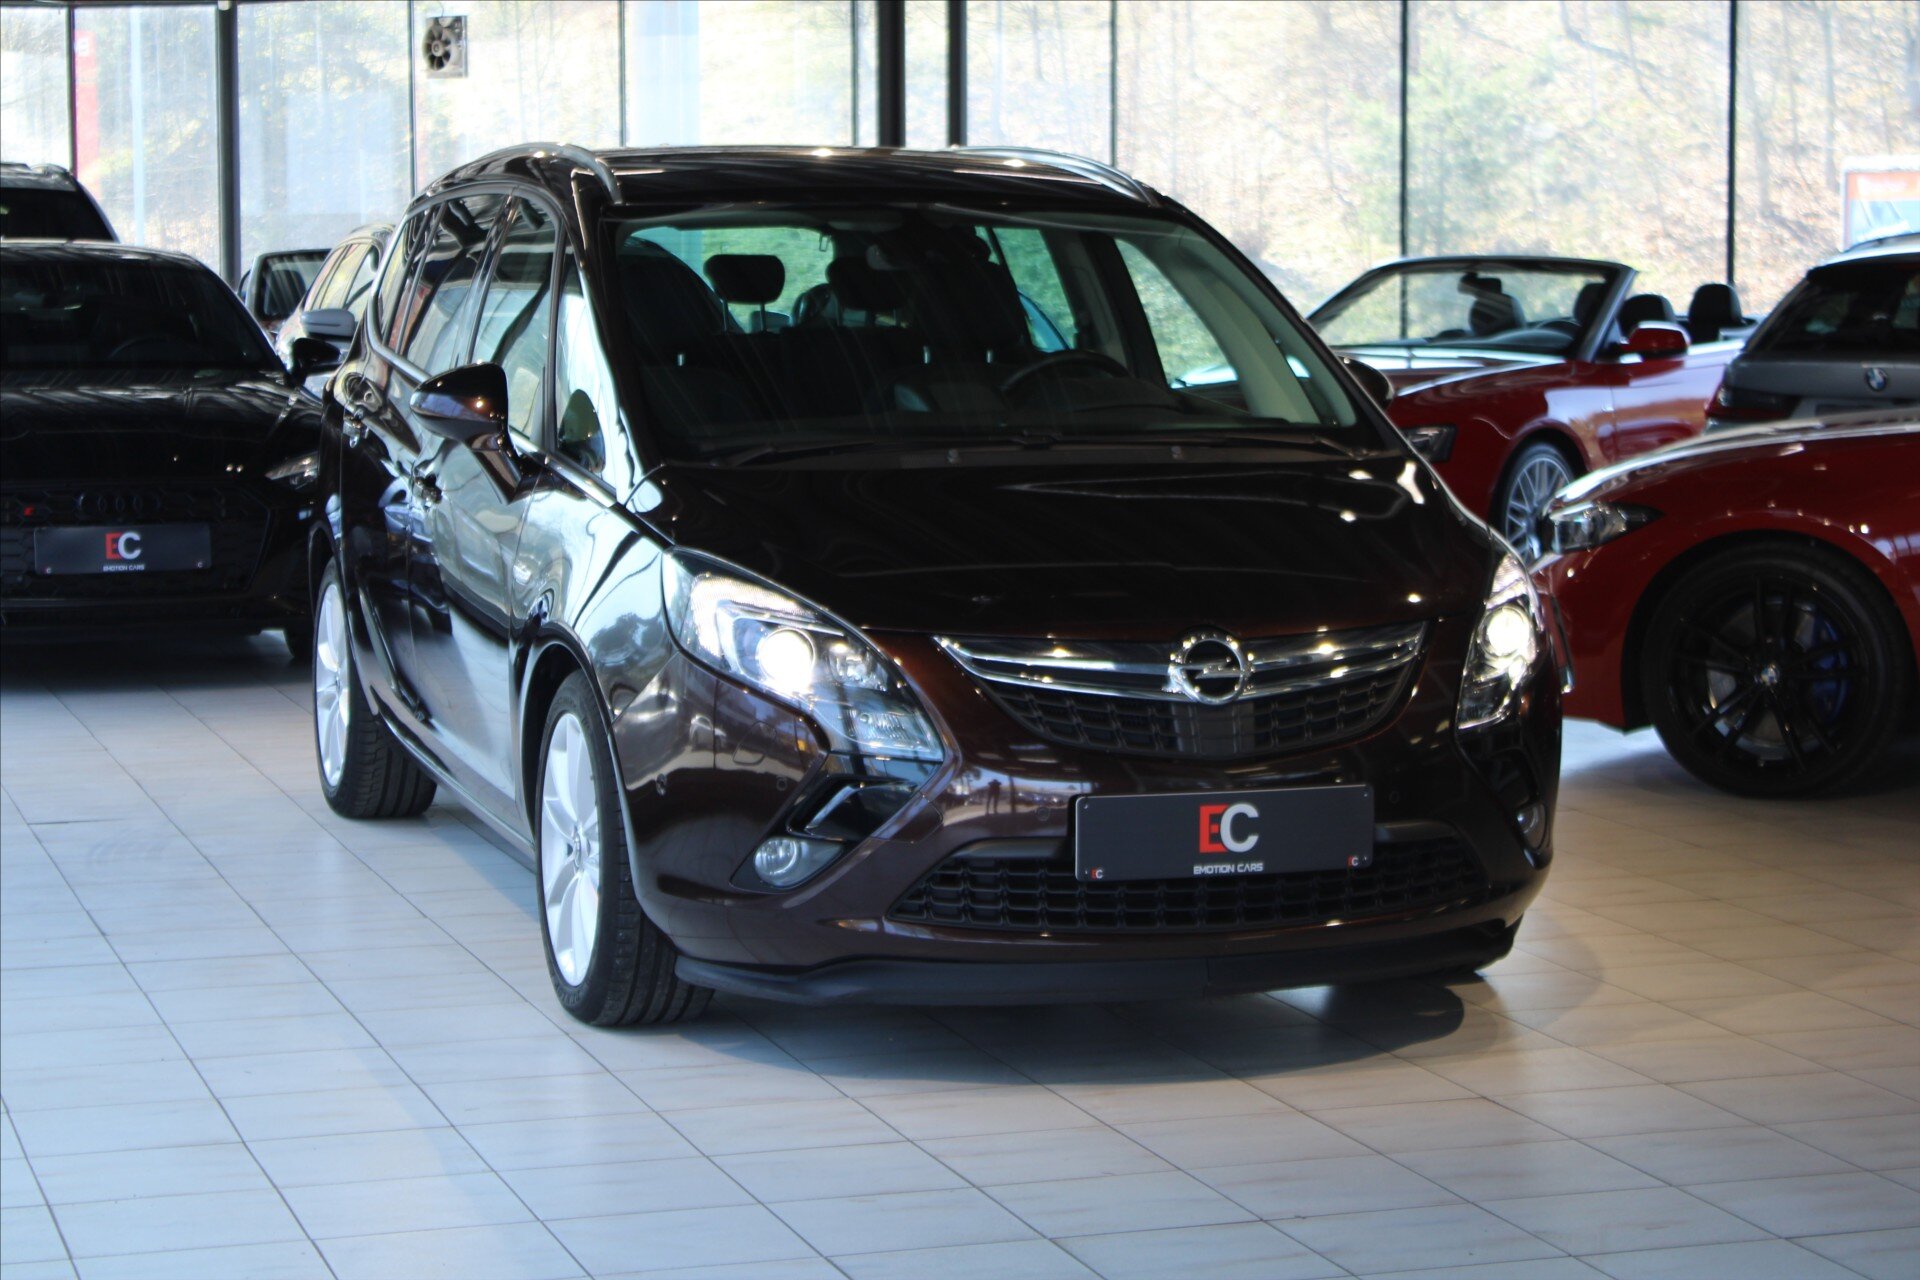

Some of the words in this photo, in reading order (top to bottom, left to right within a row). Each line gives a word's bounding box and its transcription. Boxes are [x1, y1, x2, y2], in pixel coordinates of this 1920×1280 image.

[105, 531, 141, 560] EC
[1199, 803, 1259, 853] EC
[1193, 864, 1235, 875] EMOTION
[1236, 862, 1264, 873] CARS
